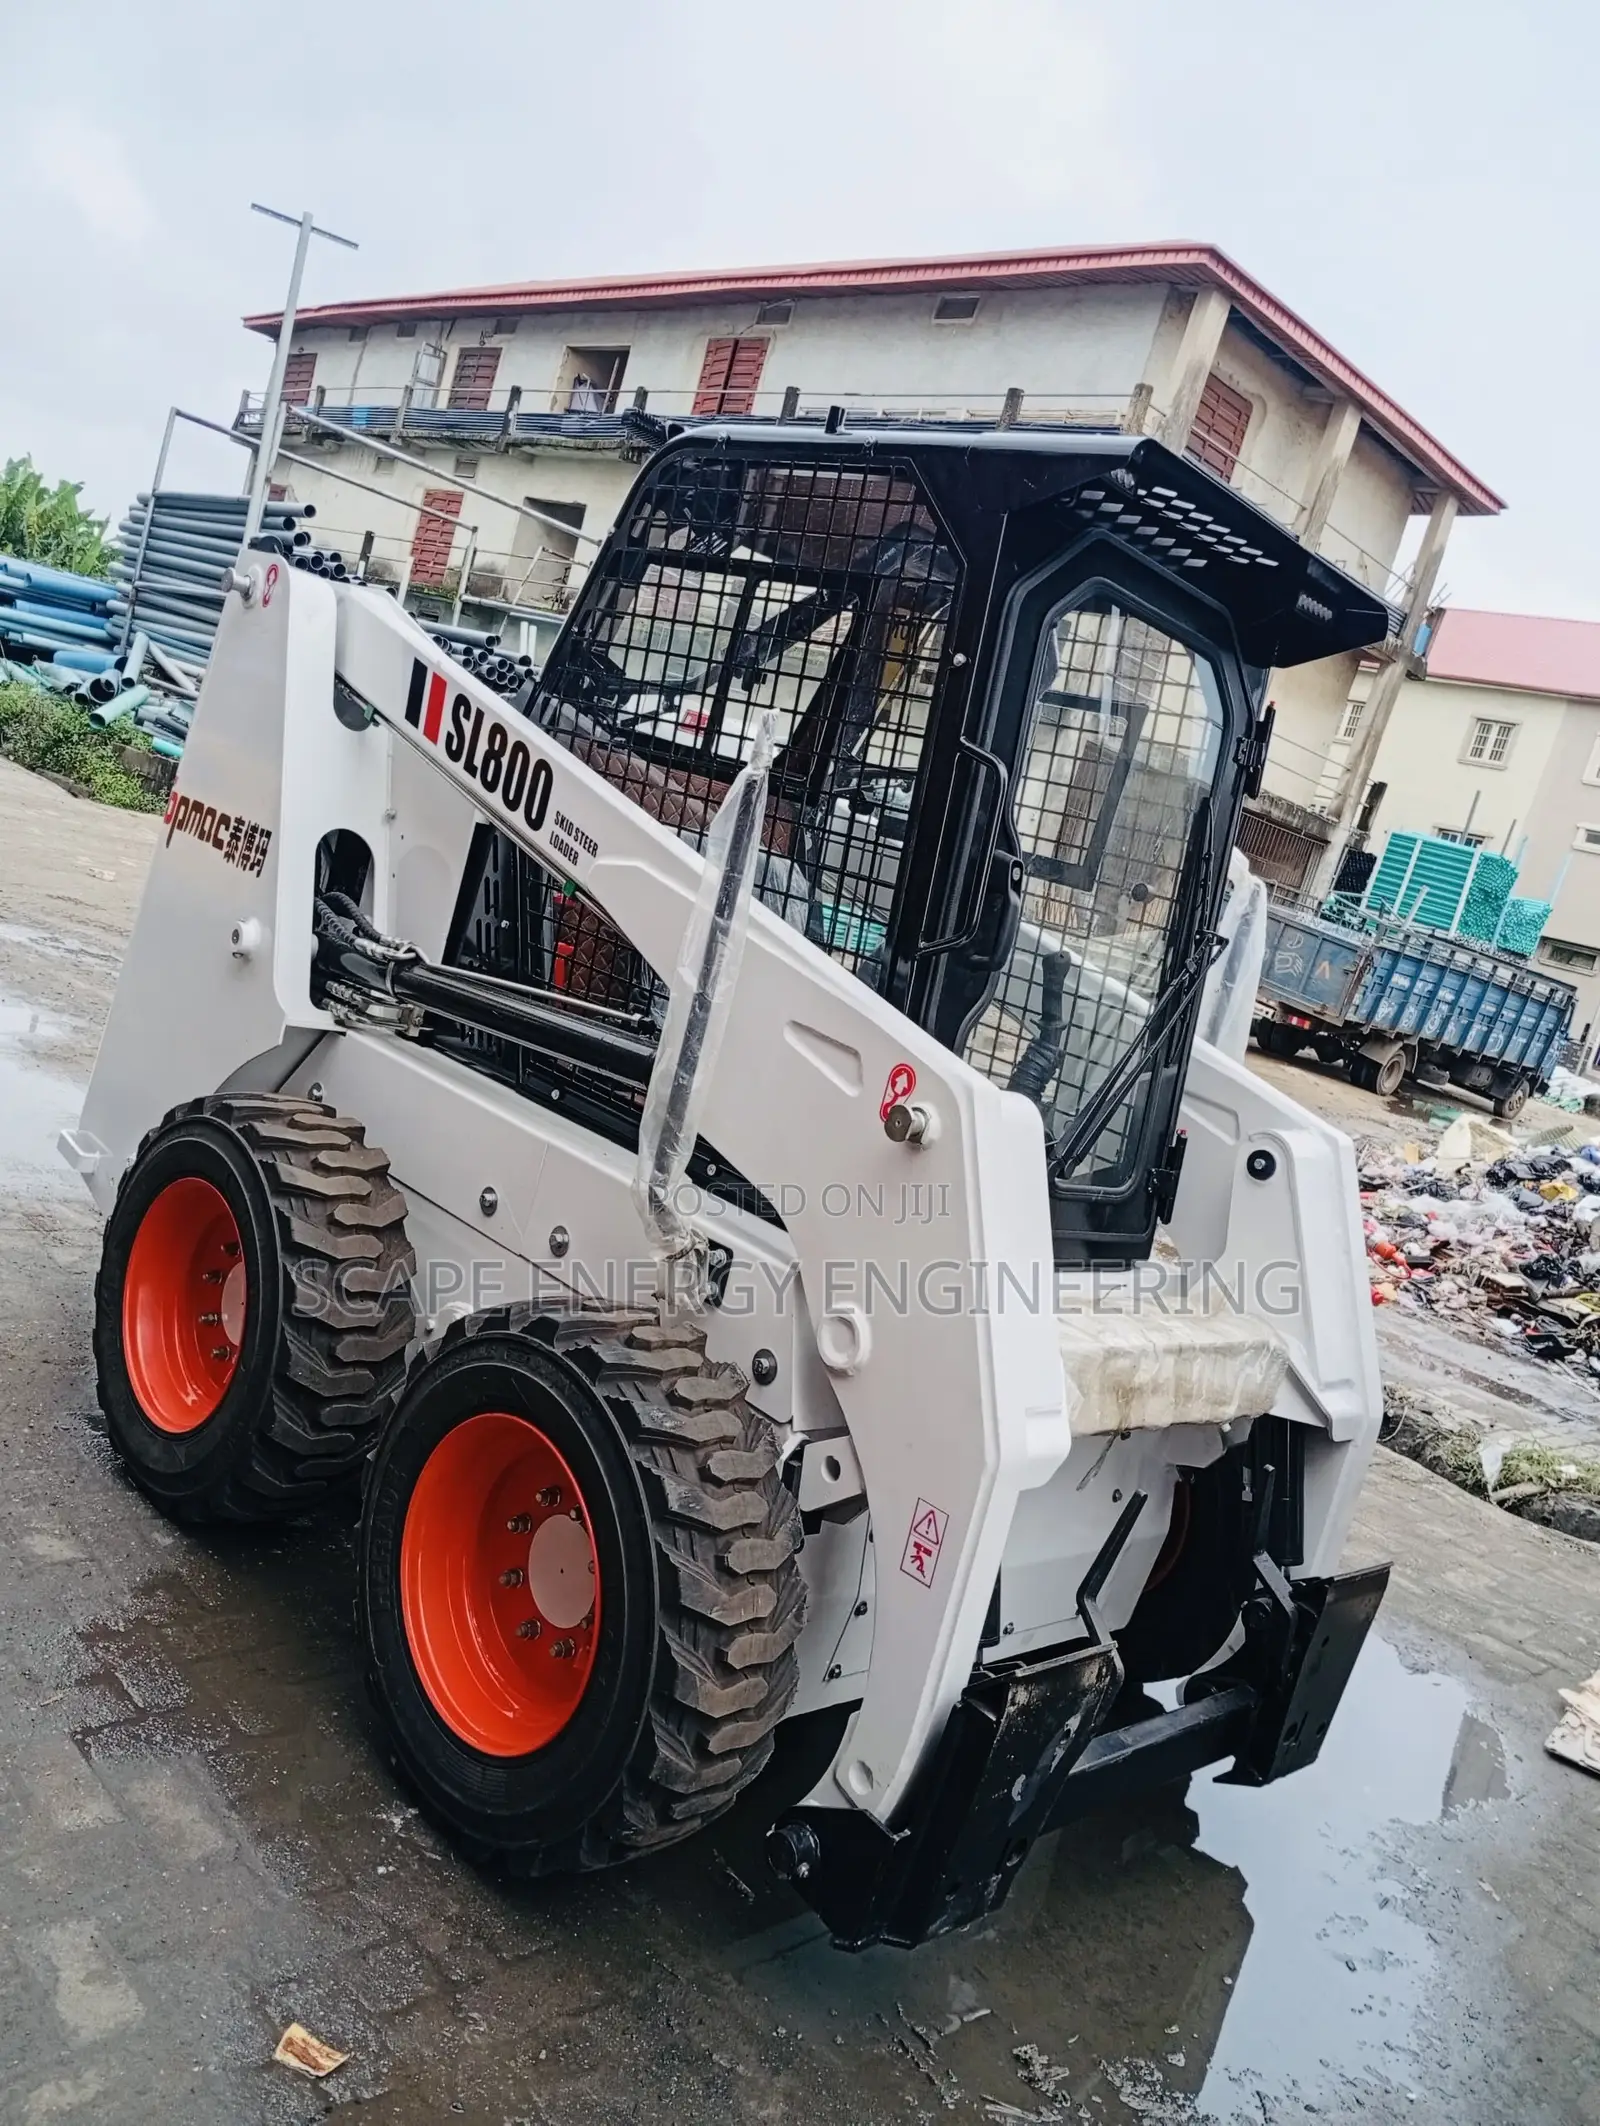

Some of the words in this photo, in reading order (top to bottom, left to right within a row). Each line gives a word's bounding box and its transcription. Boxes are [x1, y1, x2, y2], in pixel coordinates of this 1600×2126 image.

[445, 693, 553, 832] SL800
[549, 830, 579, 866] LOADER
[554, 810, 573, 836] SKID
[573, 827, 599, 858] STEER
